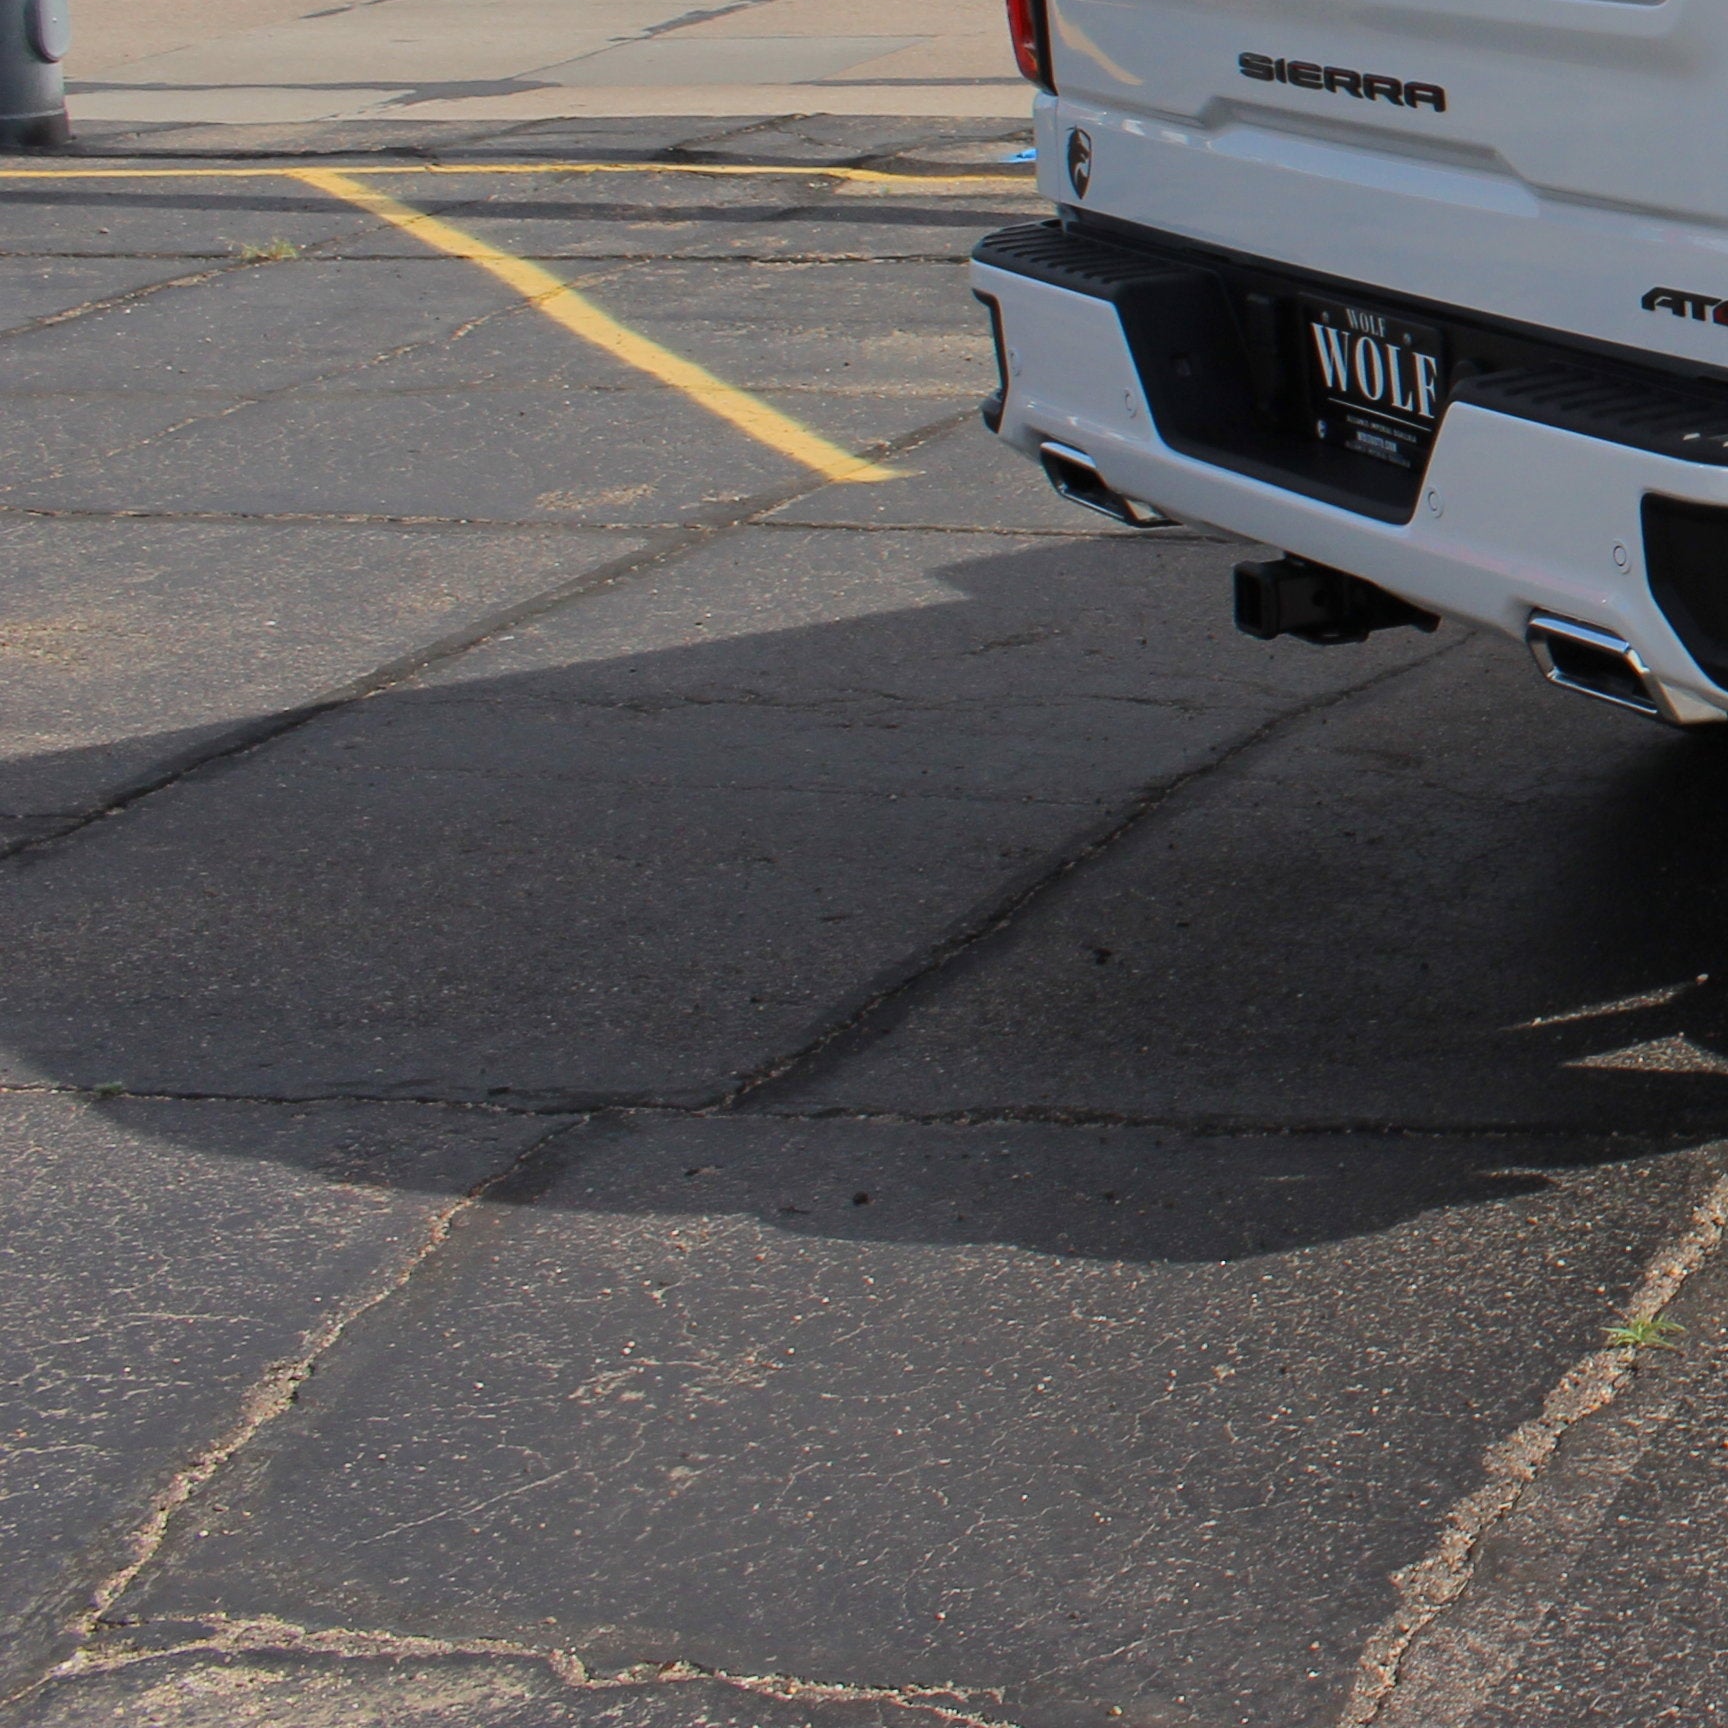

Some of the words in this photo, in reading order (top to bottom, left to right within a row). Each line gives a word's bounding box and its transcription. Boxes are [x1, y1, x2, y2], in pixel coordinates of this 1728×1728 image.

[1238, 51, 1447, 113] SIERRA
[1345, 307, 1386, 339] WOLF
[1311, 321, 1438, 420] WOLF
